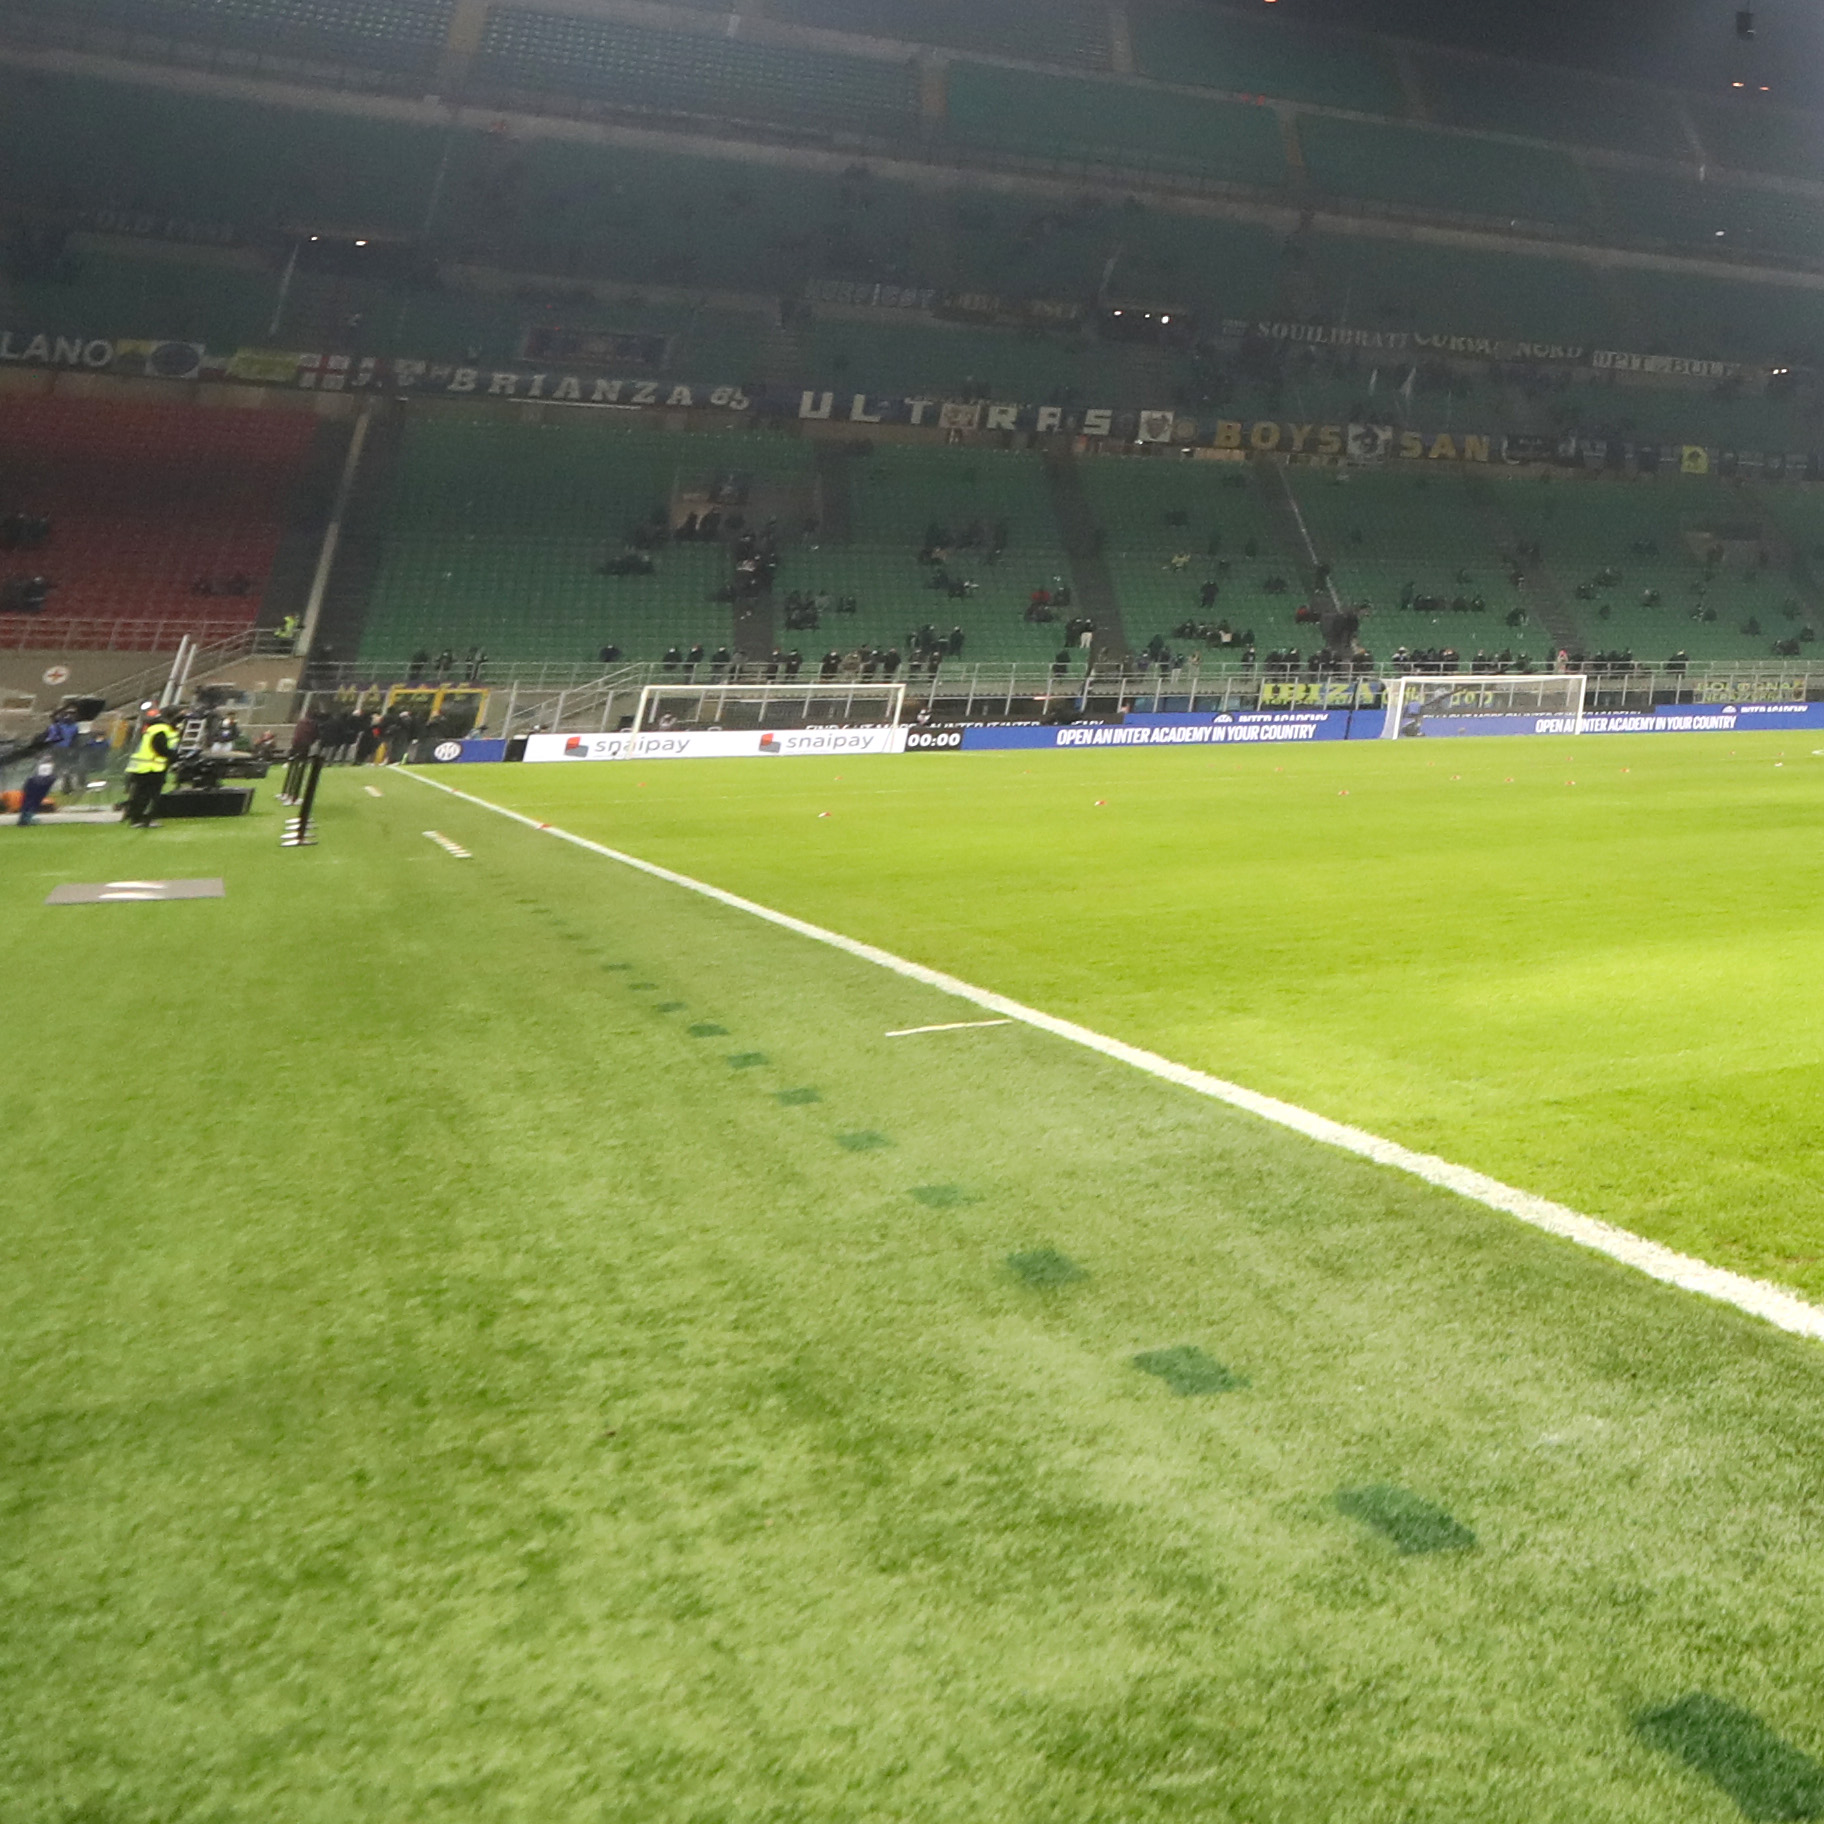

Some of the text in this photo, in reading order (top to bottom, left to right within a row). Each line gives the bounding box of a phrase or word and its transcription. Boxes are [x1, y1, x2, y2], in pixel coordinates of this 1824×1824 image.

[448, 368, 694, 407] BRIANZA
[1214, 420, 1489, 462] BOYS SAN
[1536, 719, 1564, 733] OPEN
[1579, 717, 1608, 732] NTER
[1608, 716, 1656, 732] ACADEMY
[1655, 717, 1667, 730] IN
[1667, 716, 1693, 730] YOUR
[1692, 715, 1737, 729] COUNTRY
[786, 733, 874, 750] snaipay
[907, 732, 961, 748] 00:00
[1057, 724, 1317, 745] OPEN AN INTER ACADEMY IN YOUR COUNTRY
[595, 736, 692, 755] snaipay
